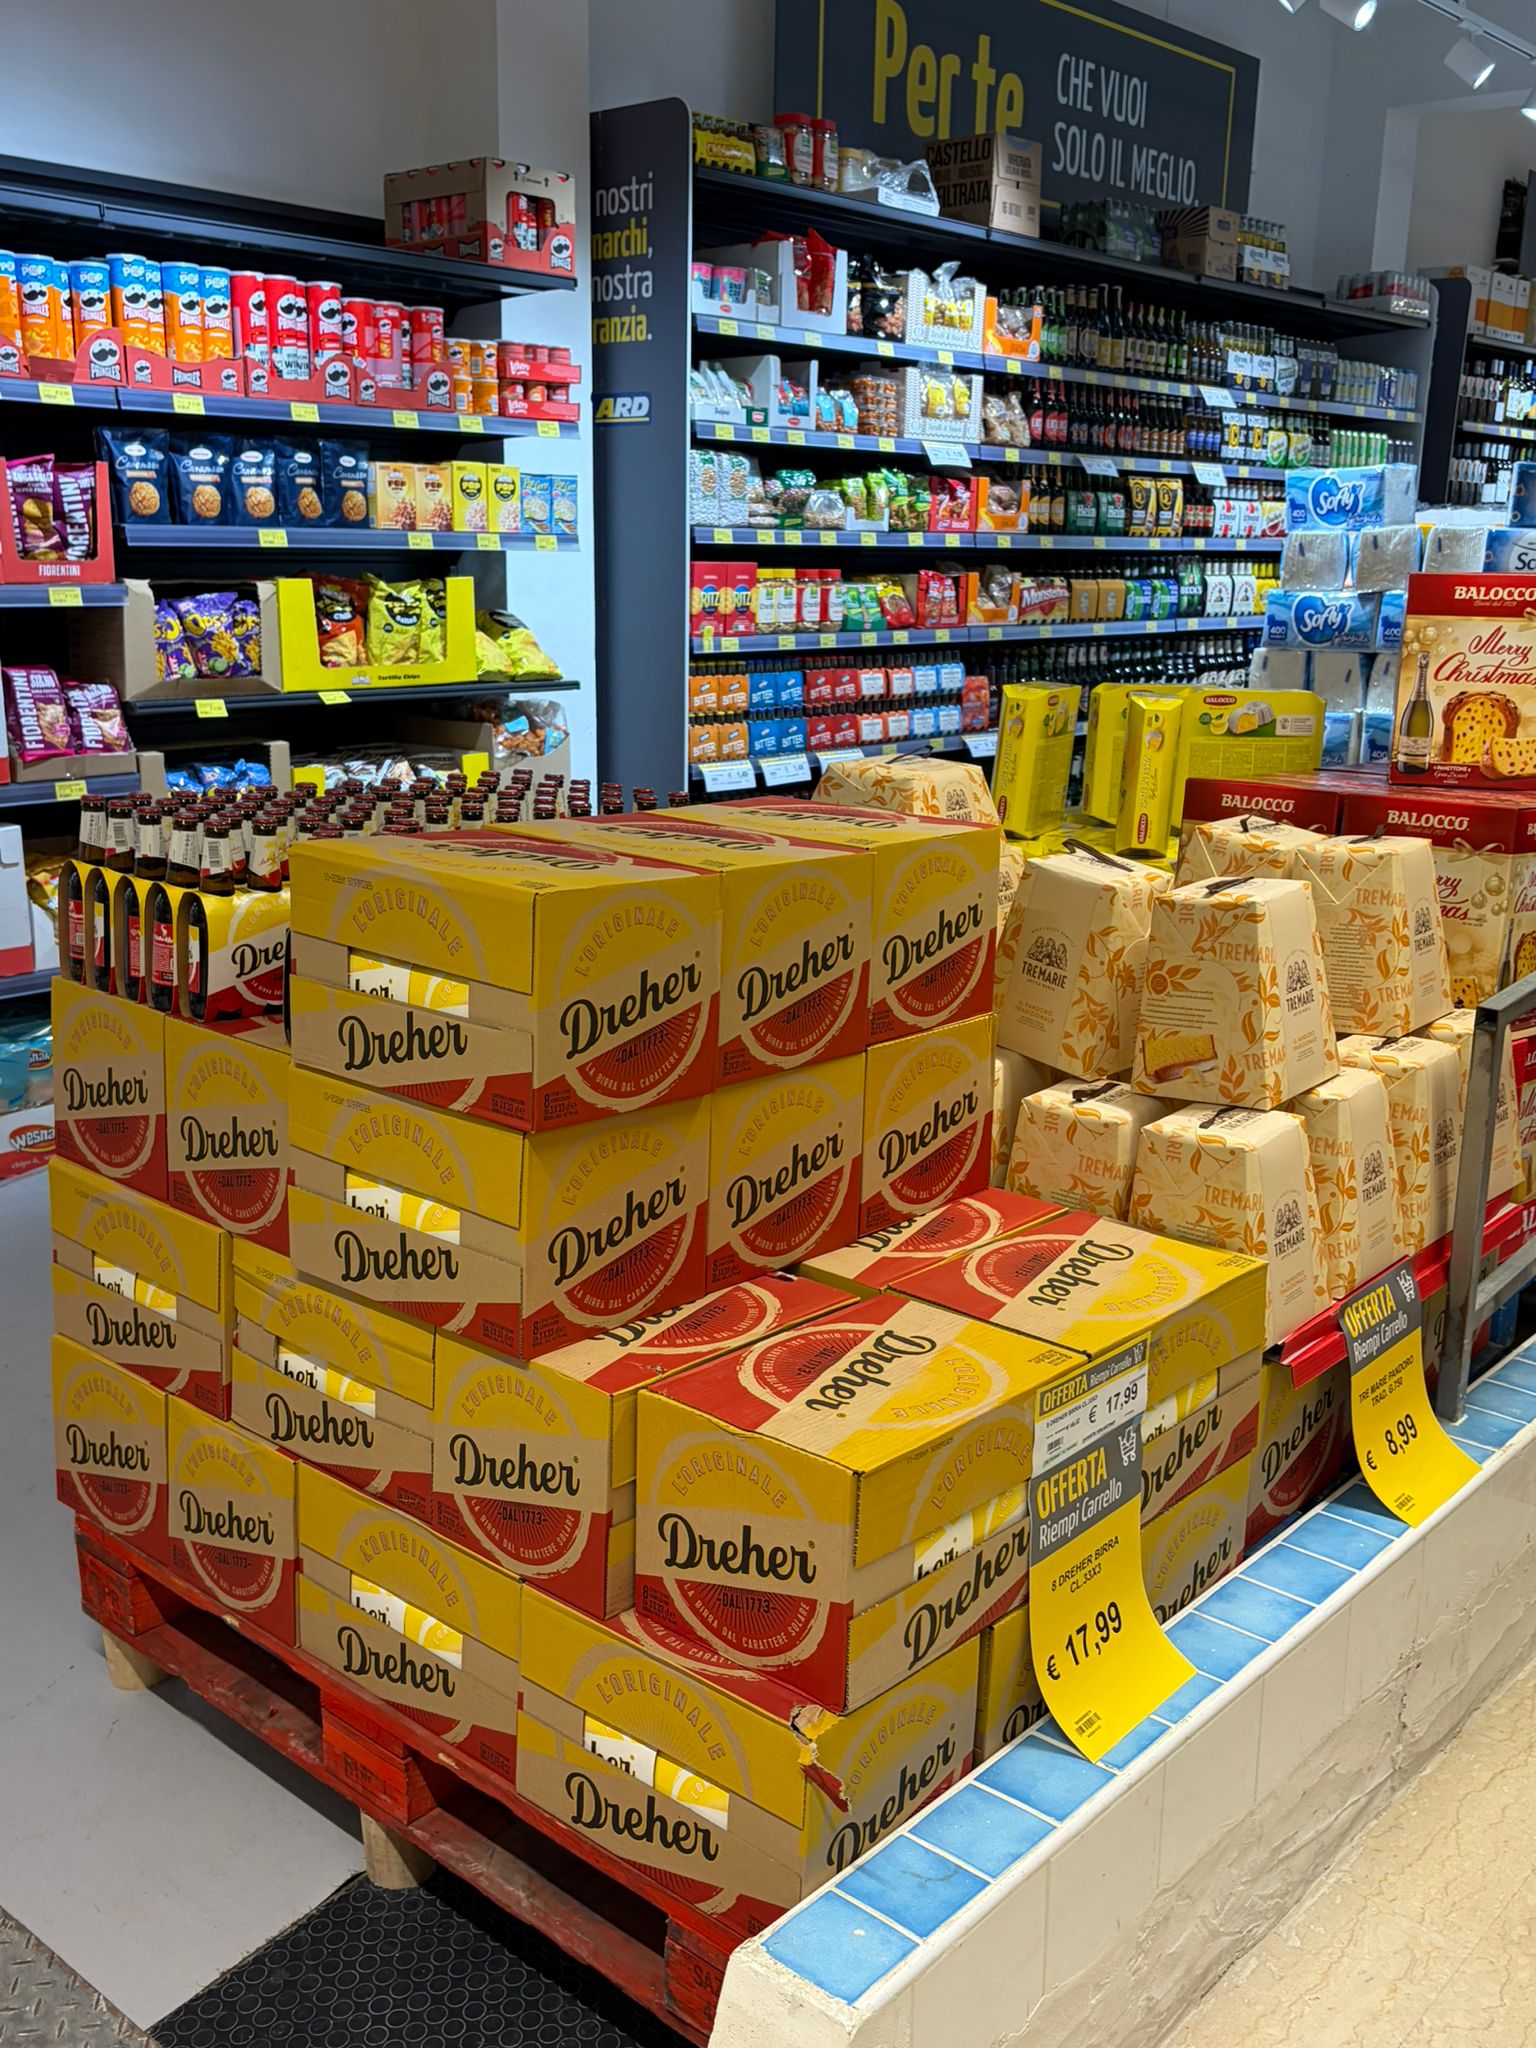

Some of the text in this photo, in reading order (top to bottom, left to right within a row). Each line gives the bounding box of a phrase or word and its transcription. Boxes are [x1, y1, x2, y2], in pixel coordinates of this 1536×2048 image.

[874, 0, 1024, 140] Per te
[1056, 53, 1147, 129] CHE VUOI
[926, 138, 992, 169] CASTELLO
[1052, 121, 1199, 208] SOLO IL MEGLIO.
[596, 171, 653, 217] nostri
[592, 264, 653, 302] nostra
[22, 303, 49, 317] PRINGLES
[80, 309, 107, 323] PRINGLES
[205, 317, 230, 331] PRINGLES
[89, 362, 121, 381] PRINGLES
[173, 368, 202, 386] PRINGLES
[595, 396, 650, 418] ARD
[495, 483, 516, 492] POP
[1291, 509, 1306, 519] 400
[38, 564, 81, 577] FIORENTINI
[701, 591, 721, 606] RITZ
[733, 591, 752, 607] RITZ
[1269, 625, 1286, 636] 400
[1384, 627, 1401, 638] 400
[1468, 624, 1533, 667] Merry
[12, 669, 45, 750] FIORENTINI
[693, 693, 717, 707] BITTER
[721, 692, 746, 706] BITTER
[751, 689, 773, 703] BITTER
[781, 687, 802, 701] BITTER
[810, 685, 832, 699] BITTER
[835, 684, 856, 697] BITTER
[1205, 696, 1236, 705] BALOCCO
[692, 742, 717, 757] BITTER
[810, 731, 831, 746] BITTER
[1371, 751, 1388, 760] 400
[736, 809, 899, 829] Dreher
[1222, 793, 1295, 813] BALOCCO
[1386, 809, 1470, 831] BALOCCO
[596, 824, 764, 852] Dreher
[1138, 814, 1148, 844] BALOCCO
[421, 841, 600, 871] Dreher
[893, 855, 968, 917] L'ORIGINALE
[353, 888, 463, 957] L'ORIGINALE
[750, 881, 837, 948] L'ORIGINALE
[577, 905, 680, 978] L'ORIGINALE
[882, 902, 984, 986] Dreher
[1413, 932, 1437, 952] TREMARIE
[737, 932, 855, 1021] Dreher
[1021, 960, 1068, 989] TREMARIE
[560, 961, 703, 1061] Dreher
[766, 976, 850, 1051] BIRRA CARATTERE SOLARE
[1286, 988, 1315, 1014] TREMARIE
[70, 1013, 132, 1054] L'ORIGINALE
[338, 1011, 468, 1071] Dreher
[585, 1011, 697, 1092] LA BIRRA DAL CARATTERE SOLARE
[62, 1067, 149, 1111] Dreher
[187, 1057, 259, 1100] L'ORIGINALE
[180, 1115, 279, 1162] Dreher
[350, 1114, 456, 1186] L'ORIGINALE
[878, 1090, 979, 1179] Dreher
[1434, 1143, 1458, 1165] TREMARIE
[562, 1130, 664, 1207] L'ORIGINALE
[726, 1131, 845, 1229] Dreher
[1361, 1177, 1388, 1200] TREMARIE
[95, 1211, 172, 1274] L'ORIGINALE
[334, 1229, 459, 1283] Dreher
[548, 1174, 687, 1288] Dreher
[1273, 1226, 1306, 1258] TREMARIE
[573, 1222, 683, 1310] LA BIRRA DAL CARATTERE SOLARE
[1028, 1240, 1134, 1308] Dreher
[85, 1302, 176, 1350] Dreher
[278, 1293, 373, 1366] L'ORIGINALE
[1343, 1282, 1397, 1339] OFFERTA
[1353, 1311, 1408, 1364] Riempi Carrello
[805, 1329, 938, 1412] Dreher
[888, 1356, 976, 1419] L'ORIGINALE
[1043, 1355, 1132, 1412] OFFERTA Riempi Carrello
[1358, 1354, 1415, 1405] TRE MARIE PANDORO
[70, 1376, 134, 1420] L'ORIGINALE
[265, 1391, 375, 1449] Dreher
[461, 1371, 559, 1428] L'ORIGINALE
[1050, 1410, 1068, 1427] DREHER
[1068, 1403, 1082, 1417] BIRRA
[1088, 1382, 1138, 1424] € 17,99
[1371, 1390, 1388, 1408] TRAD.
[65, 1423, 151, 1473] Dreher
[1261, 1384, 1336, 1490] Dreher
[1366, 1412, 1418, 1471] € 8,99
[184, 1438, 255, 1490] L'ORIGINALE
[449, 1433, 581, 1497] Dreher
[672, 1451, 788, 1510] L'ORIGINALE
[932, 1426, 1034, 1511] L'ORIGINALE
[1036, 1447, 1107, 1520] OFFERTA
[179, 1488, 276, 1547] Dreher
[471, 1498, 576, 1560] LA BIRRA DAL CARATTERE SOLARE
[1039, 1477, 1122, 1552] Riempi Carrello
[359, 1526, 460, 1609] L'ORIGINALE
[657, 1511, 817, 1586] Dreher
[1058, 1553, 1093, 1588] DREHER
[1094, 1535, 1120, 1562] BIRRA
[904, 1522, 1030, 1671] Dreher
[1069, 1562, 1103, 1594] CL.33X3
[683, 1582, 695, 1599] LA
[695, 1599, 719, 1631] BIRRA
[721, 1628, 738, 1644] DAL
[742, 1631, 789, 1651] CARATTERE
[790, 1600, 811, 1638] SOLARE
[1046, 1600, 1123, 1682] € 17,99
[336, 1625, 457, 1700] Dreher
[596, 1668, 727, 1763] L'ORIGINALE
[564, 1770, 720, 1863] Dreher
[826, 1731, 956, 1875] Dreher
